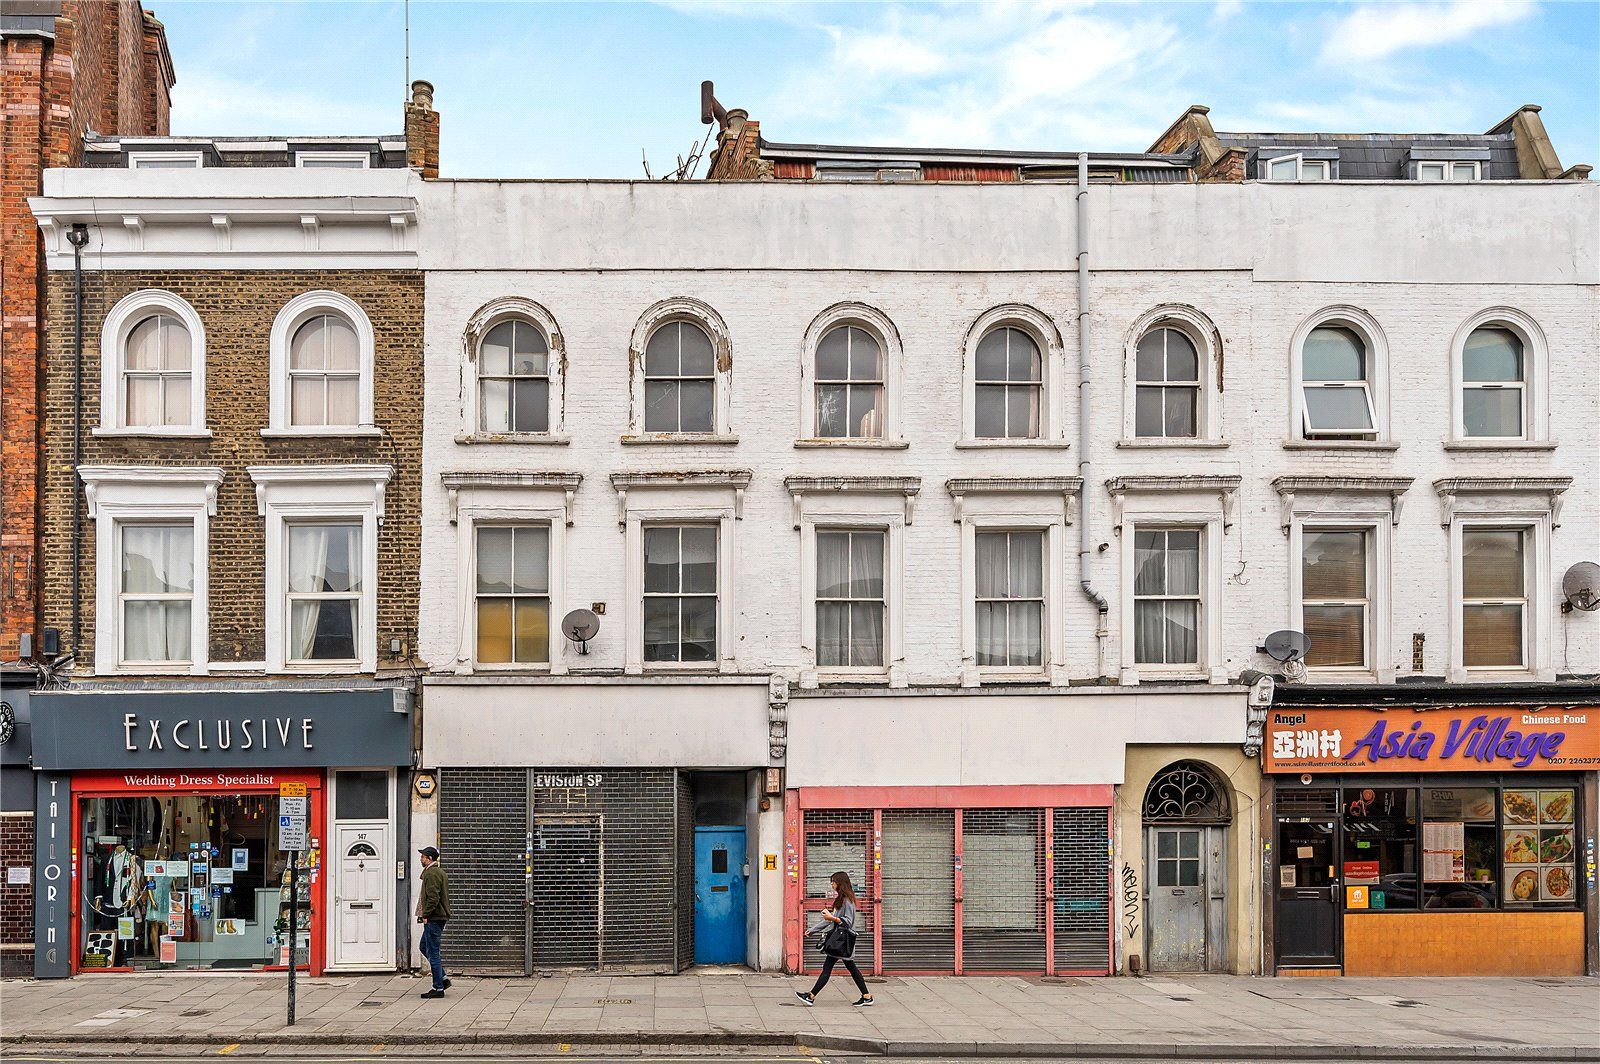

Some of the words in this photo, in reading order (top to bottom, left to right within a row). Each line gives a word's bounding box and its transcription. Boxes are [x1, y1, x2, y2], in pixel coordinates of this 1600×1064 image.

[1274, 714, 1306, 726] Angel
[1522, 714, 1560, 724] Chinese
[1563, 714, 1586, 724] Food
[1272, 729, 1342, 758] 亞洲村
[1342, 719, 1436, 762] Asia
[1440, 715, 1566, 767] Village
[124, 775, 176, 788] Wedding
[179, 774, 212, 785] Dress
[217, 774, 274, 786] Specialist
[534, 774, 583, 786] EVISION
[587, 774, 602, 786] SP
[44, 781, 61, 964] TAILORING
